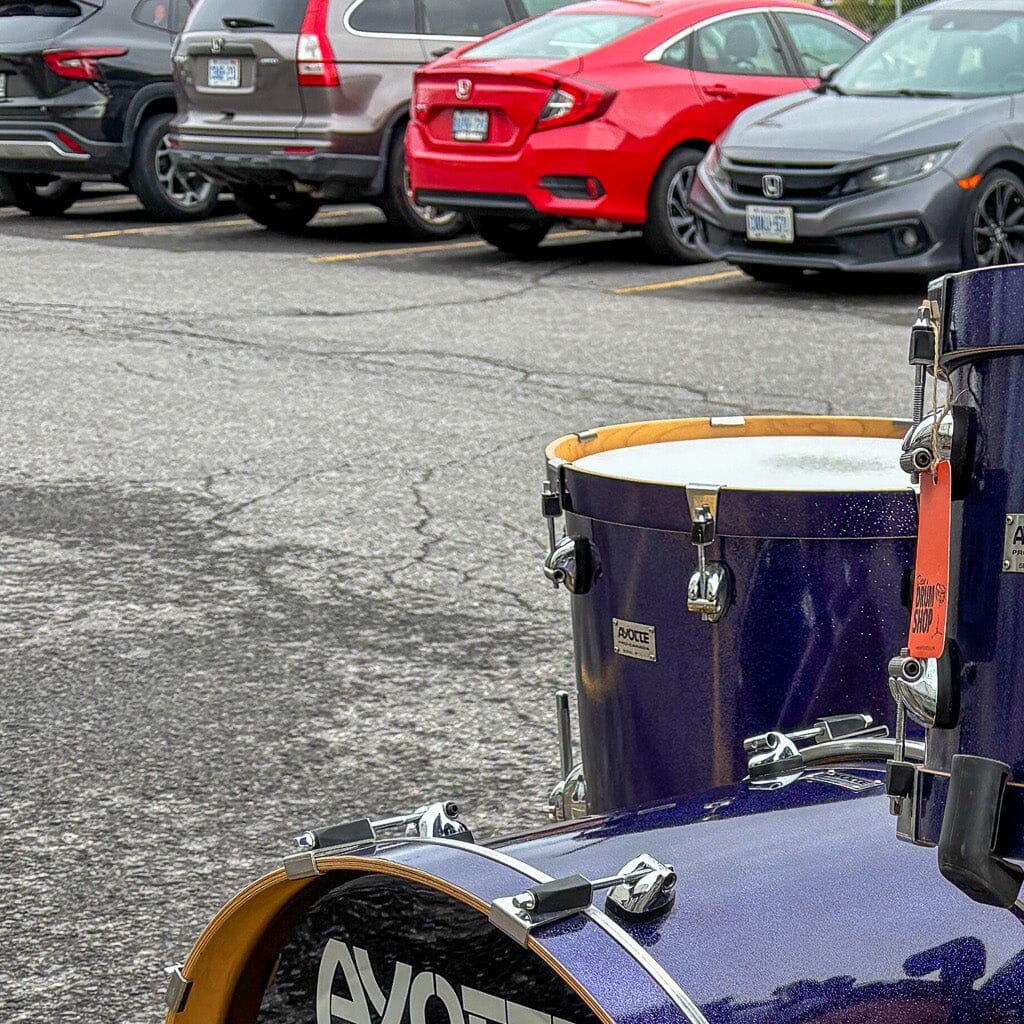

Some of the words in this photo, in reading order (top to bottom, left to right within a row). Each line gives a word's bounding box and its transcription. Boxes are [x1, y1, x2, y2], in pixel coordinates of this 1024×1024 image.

[915, 585, 936, 609] DRUM
[911, 608, 934, 634] SHOP
[618, 626, 650, 645] AYOTTE
